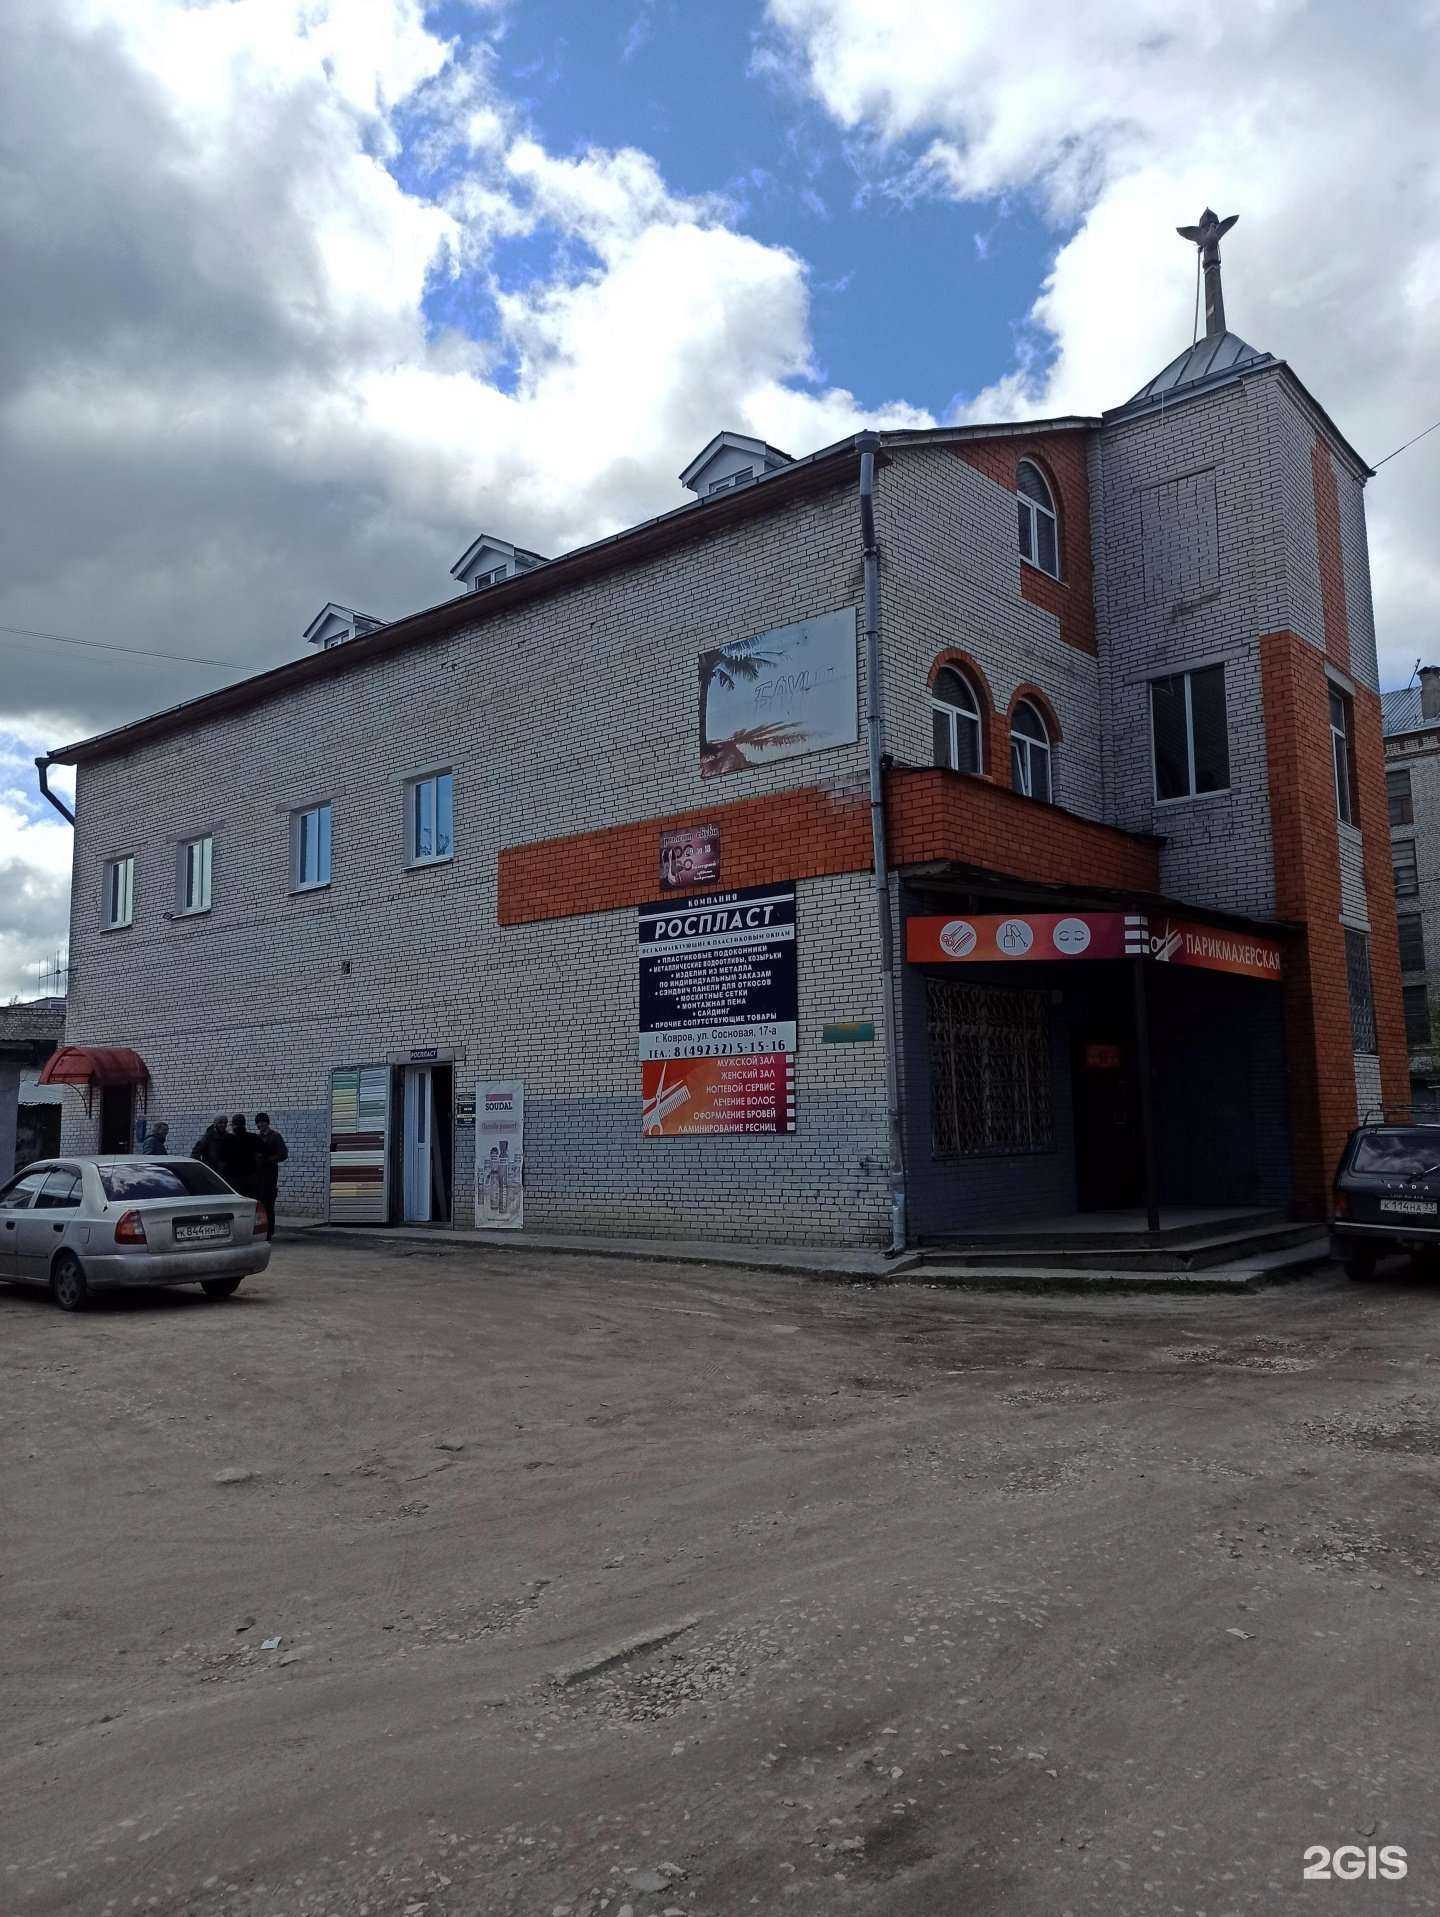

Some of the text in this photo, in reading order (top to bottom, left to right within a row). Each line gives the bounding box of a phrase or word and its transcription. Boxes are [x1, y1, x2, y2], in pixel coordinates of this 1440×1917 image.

[655, 905, 774, 939] РОСПЛАСТ
[662, 945, 768, 964] ПЛАСТИКОВЫЕ ПОДОКОННИКИ
[1186, 933, 1280, 970] ПАРИКМАХЕРСКАЯ
[653, 961, 702, 973] МЕТАЛЛИЧЕСКИЕ
[748, 951, 782, 962] КОЗЫРЬКИ
[676, 969, 707, 979] ИЗДЕЛИЯ
[720, 964, 752, 974] МЕТАЛЛА
[669, 974, 737, 987] ИНДИВИДУАЛЬНЫМ
[738, 970, 772, 980] ЗАКАЗАМ
[692, 985, 720, 993] ПАНЕЛИ
[721, 983, 736, 991] ДЛЯ
[738, 979, 771, 988] ОТКОСОВ
[680, 989, 748, 1002] МОСКИТНЫЕ СЕТКИ
[682, 1000, 726, 1010] МОНТАЖНАЯ
[697, 1008, 730, 1016] САЙДИНГ
[655, 1013, 777, 1028] ПРОЧИЕ СОПУТСТВУЮЩИЕ ТОВАРЫ
[662, 1033, 695, 1044] Ковров,
[697, 1034, 708, 1042] ул.
[711, 1028, 756, 1039] Сосновая,
[759, 1026, 777, 1035] 17-а
[674, 1047, 681, 1057] 8
[684, 1043, 733, 1057] (49232)
[737, 1040, 786, 1053] 5-15-16
[717, 1056, 775, 1067] МУЖСКОЙ ЗАЛ
[721, 1068, 775, 1080] ЖЕНСКИЙ ЗАЛ
[706, 1082, 775, 1094] НОГТЕВОЙ СЕРВИС
[485, 1101, 513, 1111] SOUDAL
[713, 1096, 776, 1107] ЛЕЧЕНИЕ ВОЛОС
[693, 1107, 776, 1120] ОФОРМЛЕНИЕ БРОВЕЙ
[677, 1123, 777, 1134] ЛАМИНИРОВАНИЕ РЕСНИЦ
